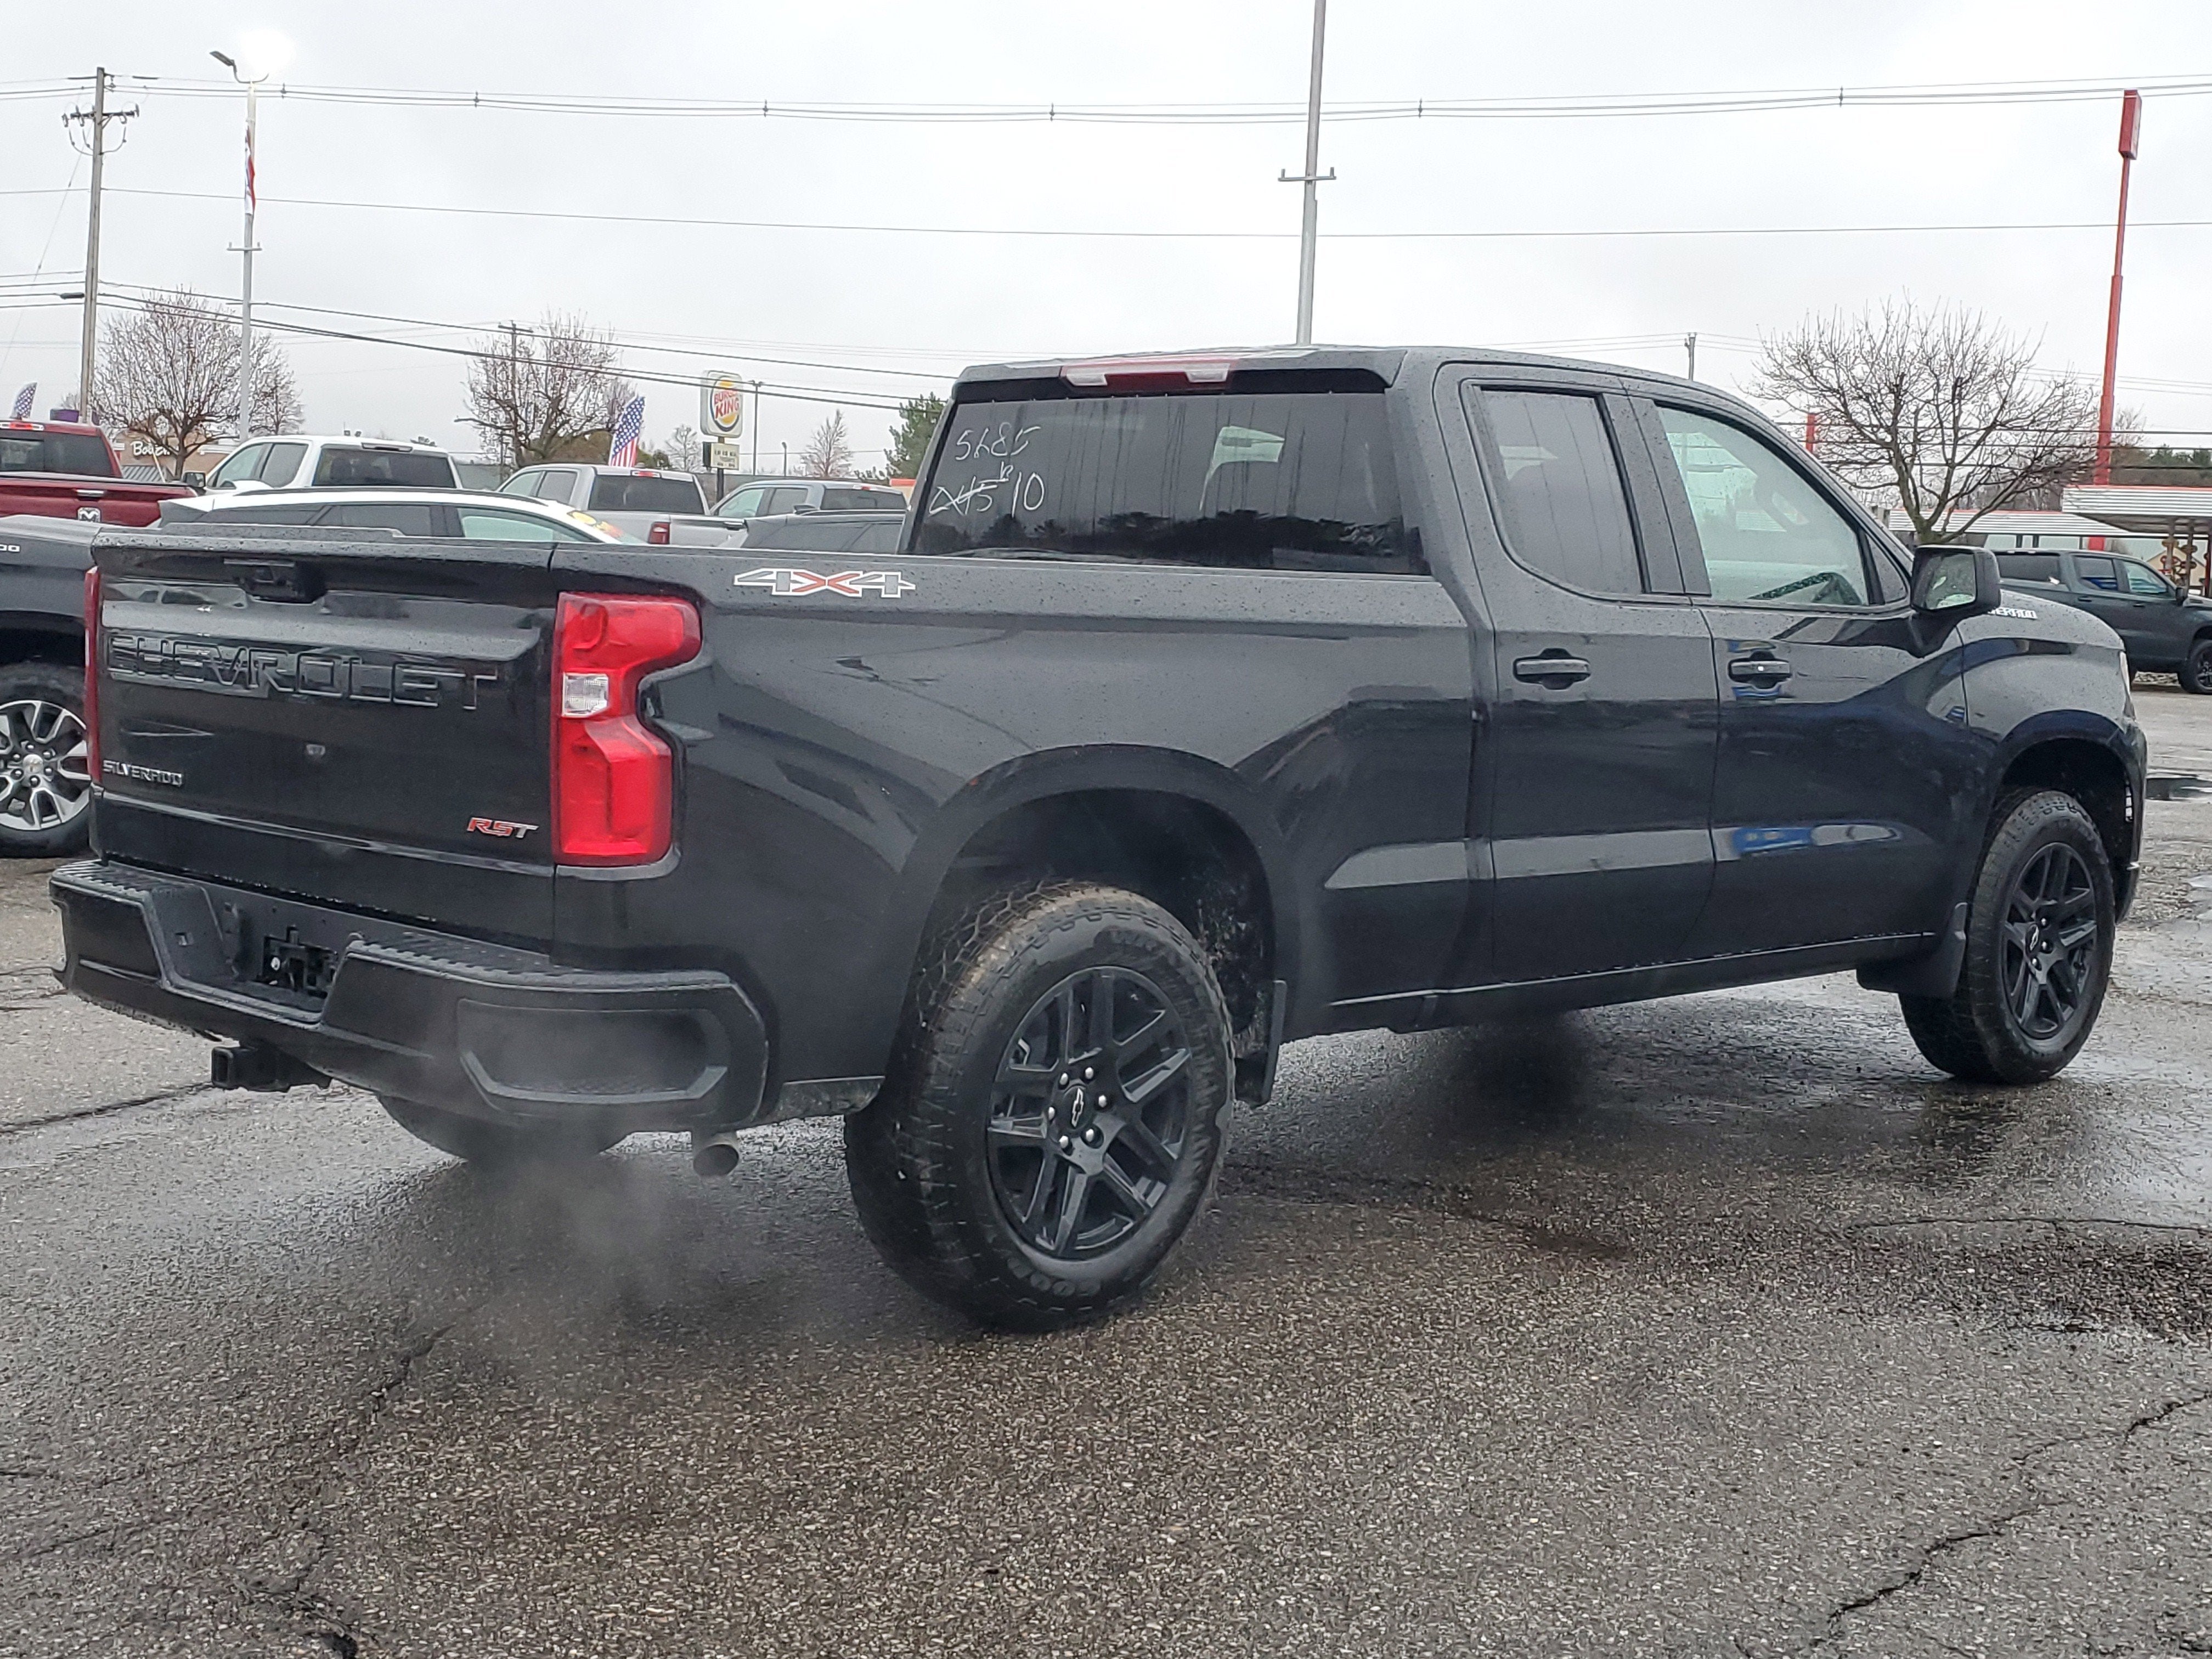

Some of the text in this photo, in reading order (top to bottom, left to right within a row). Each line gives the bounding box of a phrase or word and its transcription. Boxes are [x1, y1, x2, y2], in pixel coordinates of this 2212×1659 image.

[715, 397, 740, 419] KING
[1012, 472, 1045, 518] 10
[107, 633, 498, 710] CHEVROLET
[103, 759, 183, 787] SILVERADO
[467, 817, 539, 839] RST
